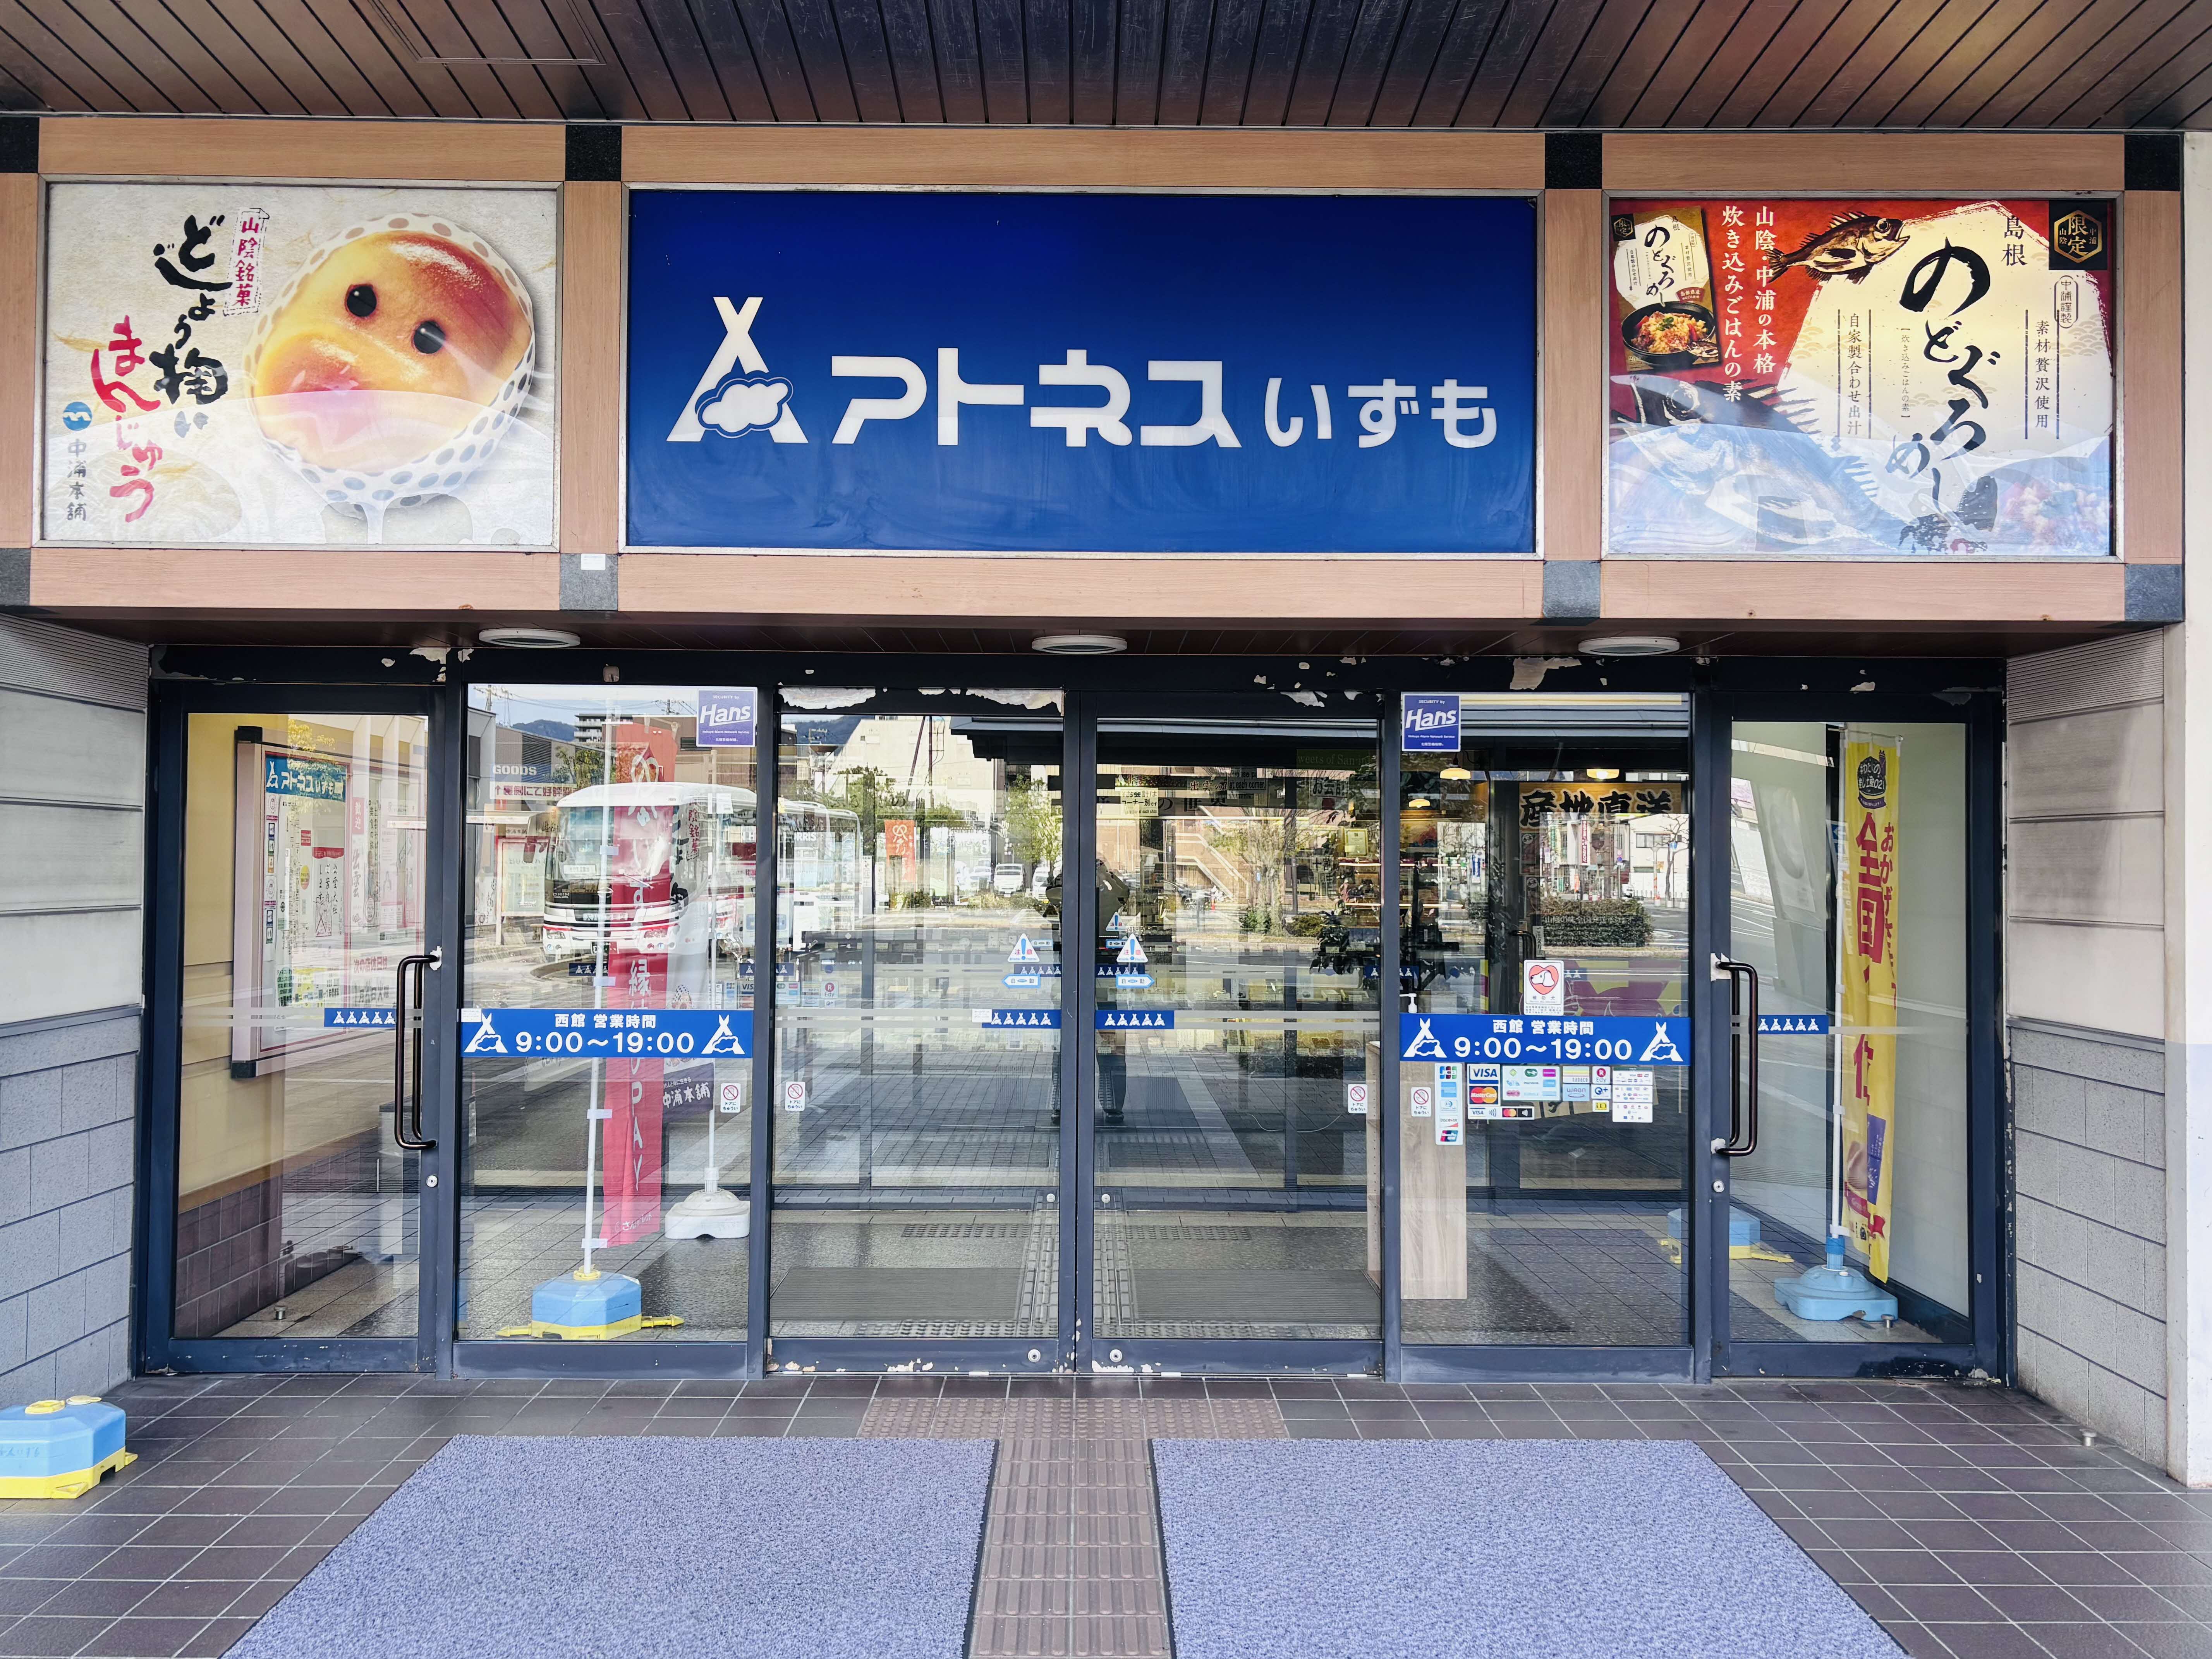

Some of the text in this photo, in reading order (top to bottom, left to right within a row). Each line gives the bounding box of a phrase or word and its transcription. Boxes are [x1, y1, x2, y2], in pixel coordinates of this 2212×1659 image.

[234, 216, 260, 307] 山陰銘菓
[2001, 215, 2028, 267] 島根
[2068, 216, 2089, 256] 限定
[1644, 224, 1676, 307] のどぐろめし
[1754, 206, 1777, 374] 山陰・中浦の本格
[149, 215, 232, 438] どじょう掬い
[1722, 205, 1745, 402] 炊き込みごはんの素
[1846, 313, 1863, 436] 自家製合わせ出汁
[1885, 236, 2001, 514] のどぐろめし
[2034, 319, 2051, 429] 素材贅沢使用
[90, 315, 163, 523] まんじゅう
[67, 438, 87, 522] 中浦本舗
[700, 704, 753, 726] Hans
[1405, 708, 1458, 731] Hans
[493, 765, 537, 775] GOODS
[1230, 781, 1234, 789] at
[1236, 779, 1247, 789] each
[515, 1031, 695, 1054] 9:00～19:00
[555, 1013, 657, 1030] 西館 営業時間
[1492, 1018, 1594, 1036] 西館 営業時間
[1454, 1036, 1632, 1060] 9:00～19:00
[1473, 1068, 1497, 1077] VISA
